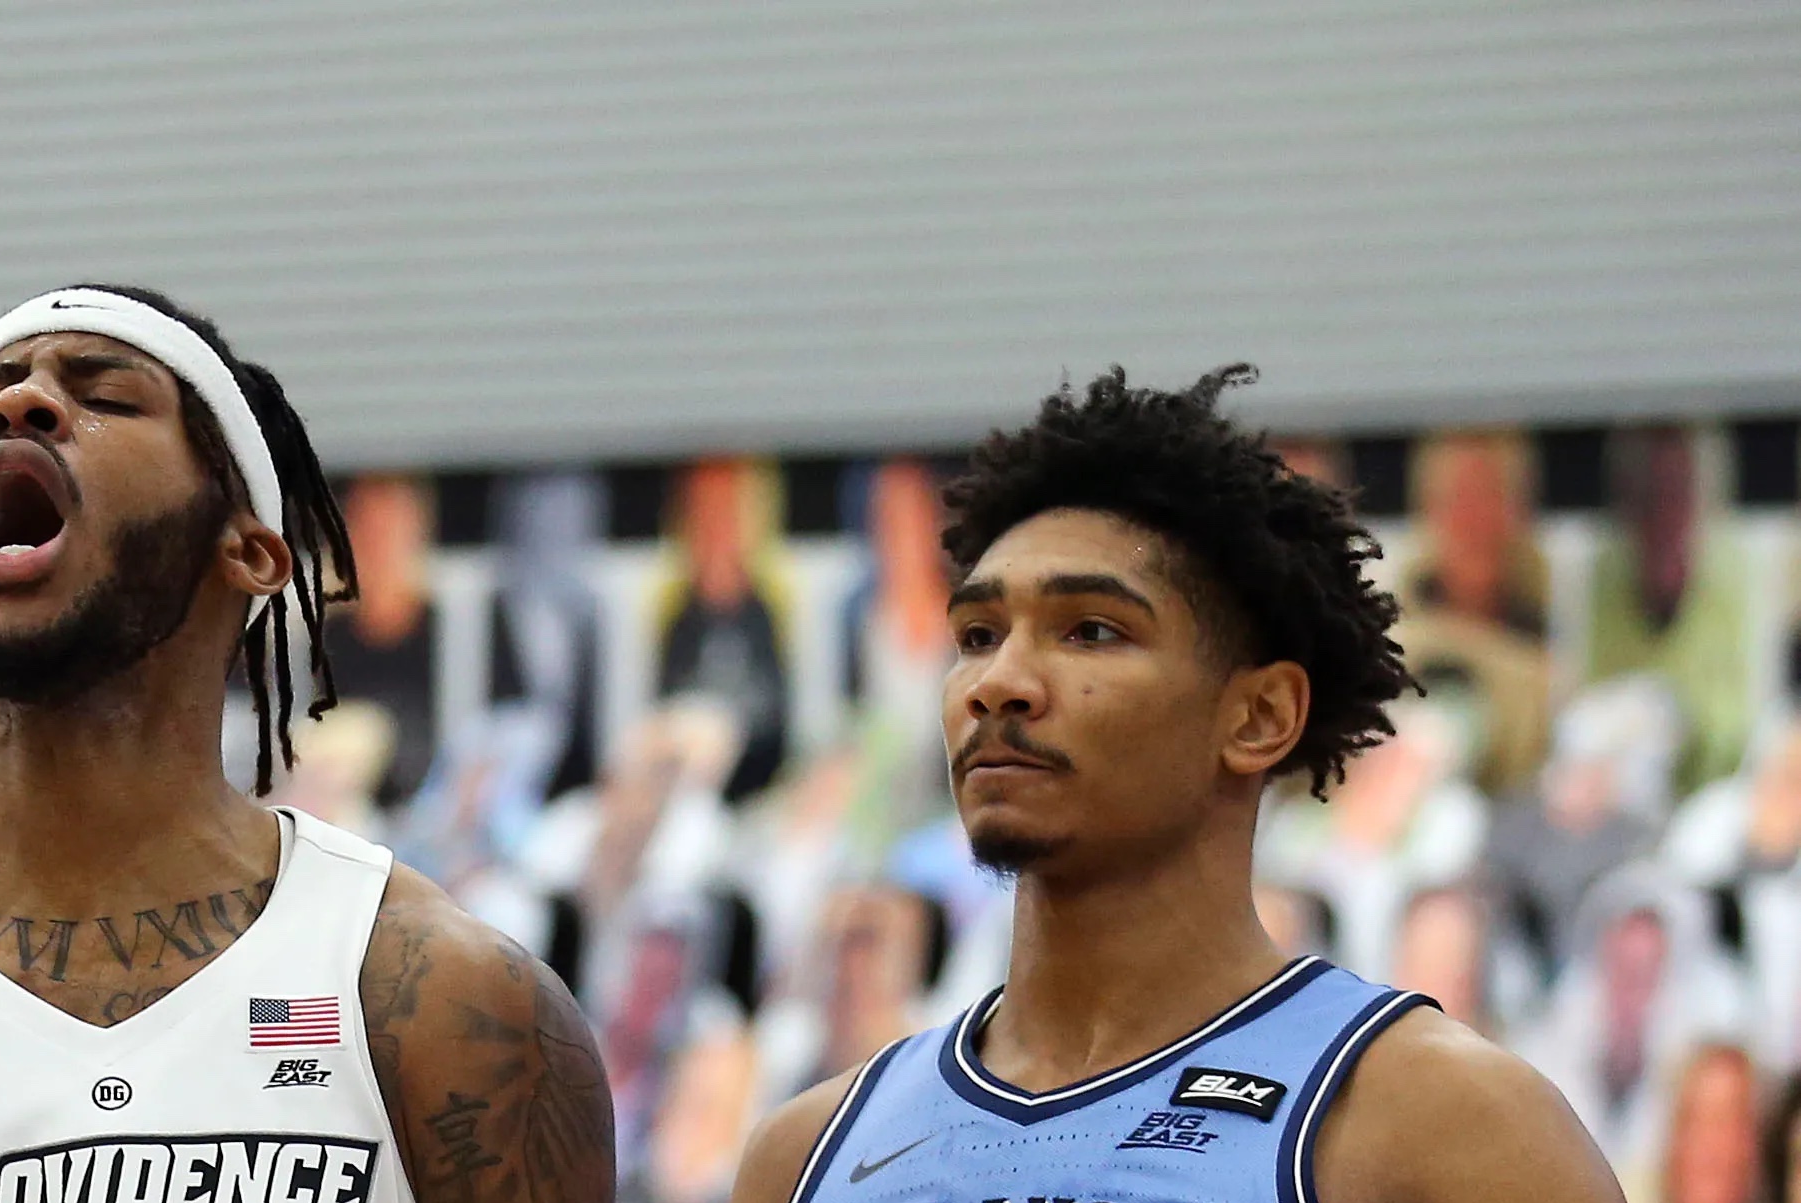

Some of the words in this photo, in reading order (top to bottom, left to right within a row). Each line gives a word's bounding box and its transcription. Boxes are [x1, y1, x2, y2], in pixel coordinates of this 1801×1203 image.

[275, 1058, 319, 1072] BIG
[269, 1070, 332, 1084] EAST
[99, 1085, 125, 1101] DG
[1187, 1074, 1276, 1101] BLM
[1140, 1111, 1206, 1130] BIG
[1125, 1127, 1219, 1146] EAST
